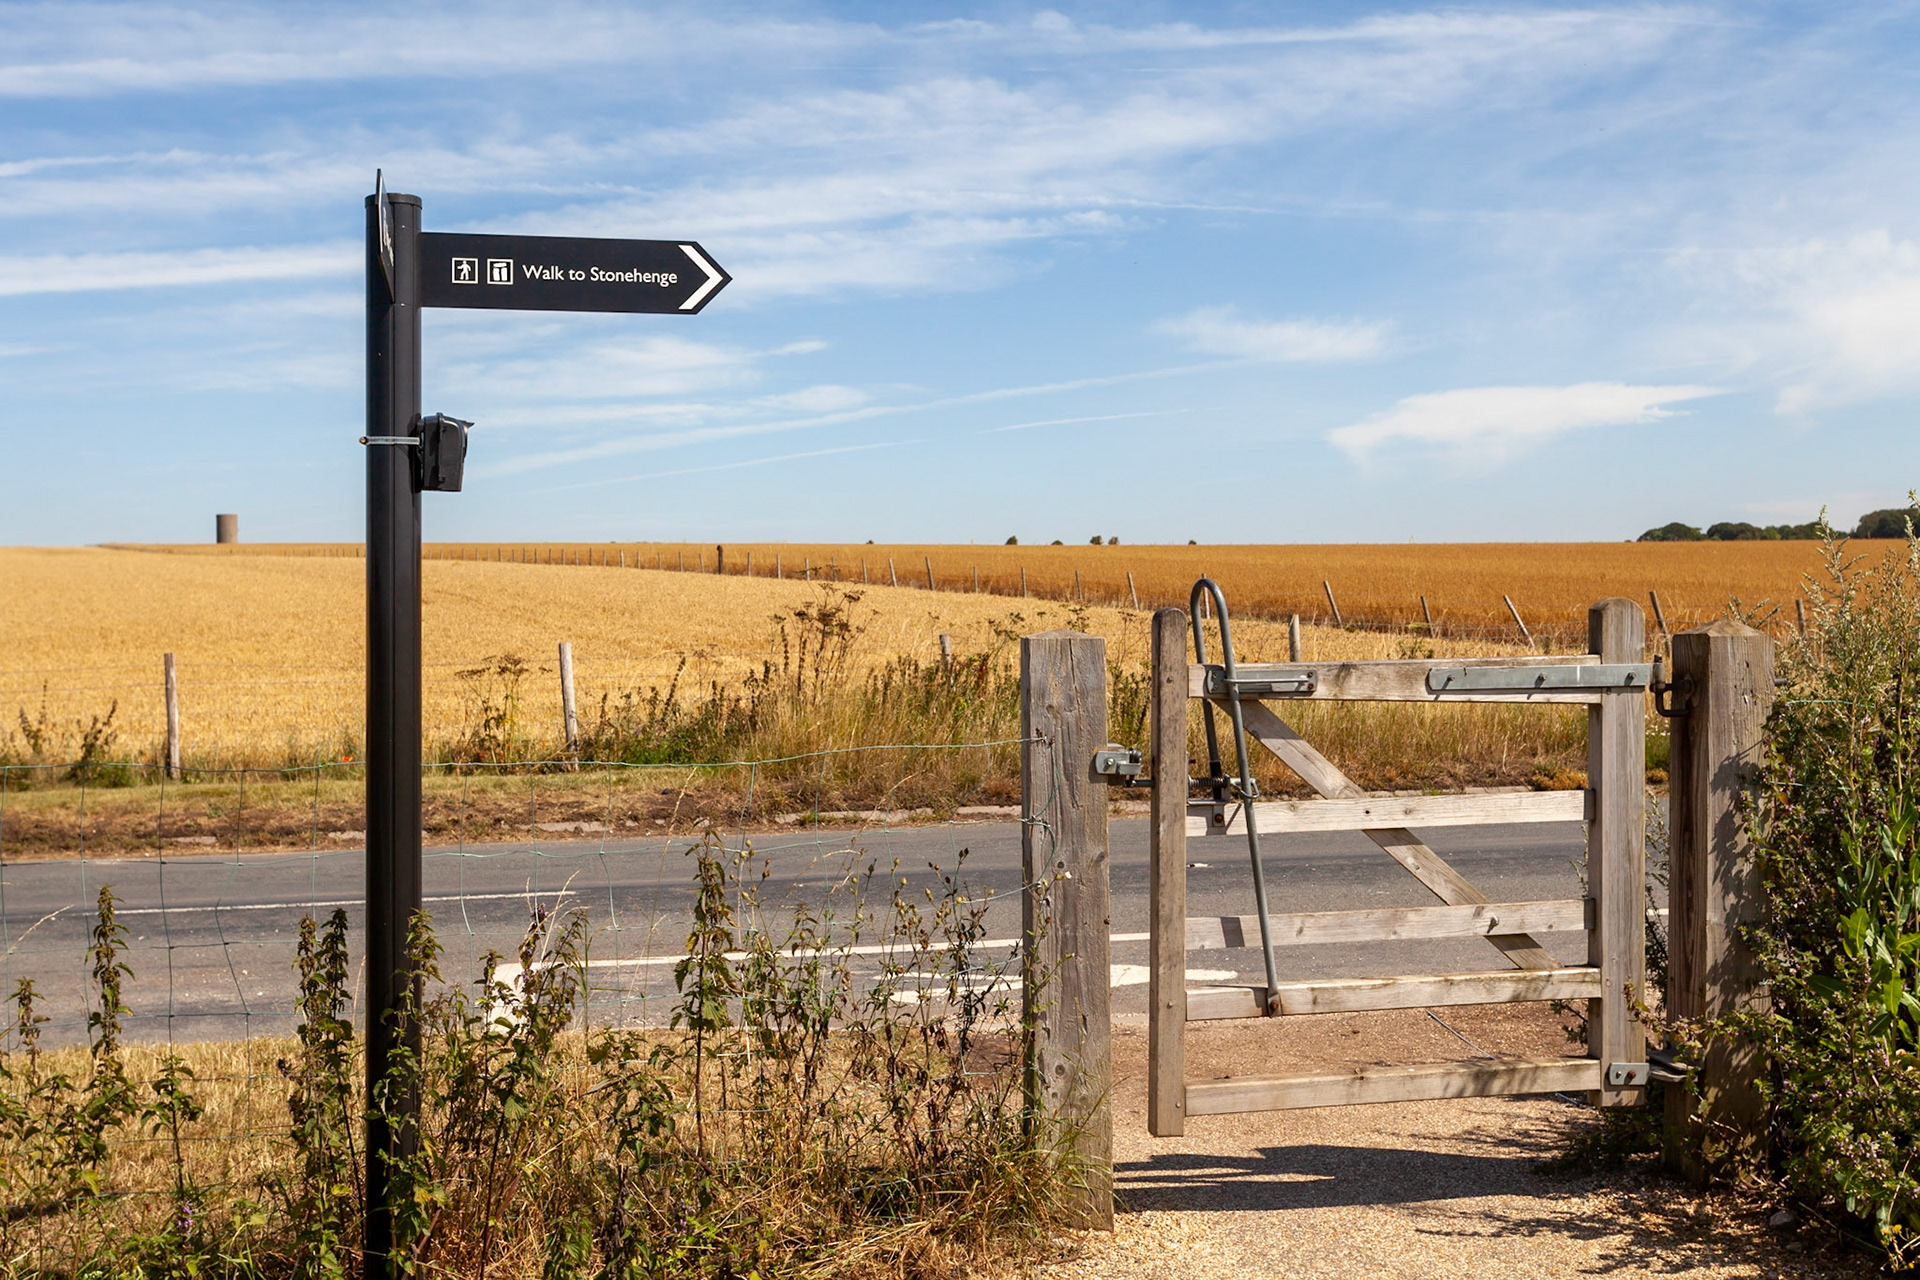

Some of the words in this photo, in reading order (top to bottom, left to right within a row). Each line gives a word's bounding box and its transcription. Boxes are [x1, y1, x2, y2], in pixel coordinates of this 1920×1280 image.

[522, 264, 565, 281] Walk
[568, 268, 586, 281] to
[590, 266, 678, 288] Stonehenge
